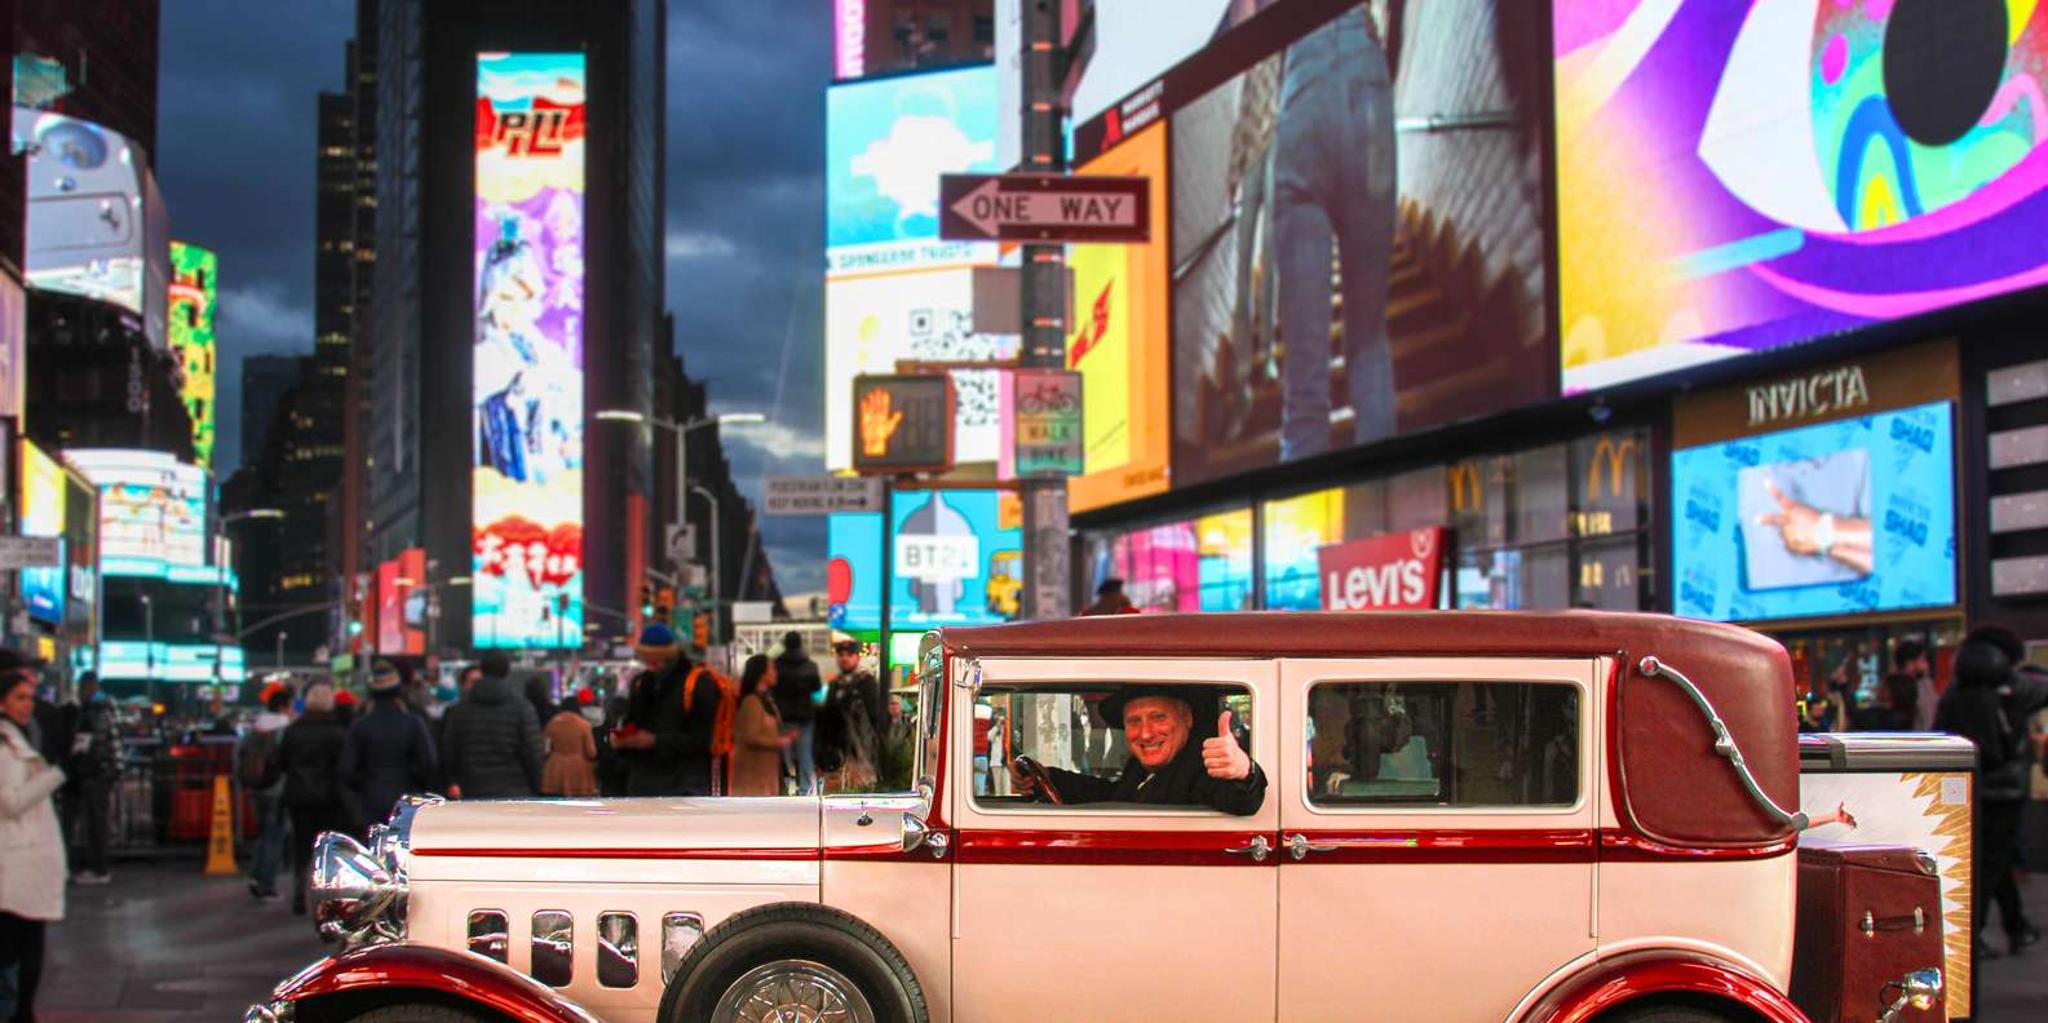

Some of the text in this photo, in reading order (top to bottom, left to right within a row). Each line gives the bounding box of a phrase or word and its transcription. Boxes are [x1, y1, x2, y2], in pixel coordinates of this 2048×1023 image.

[972, 195, 1123, 221] ONE WAY
[1747, 365, 1869, 425] INVICTA
